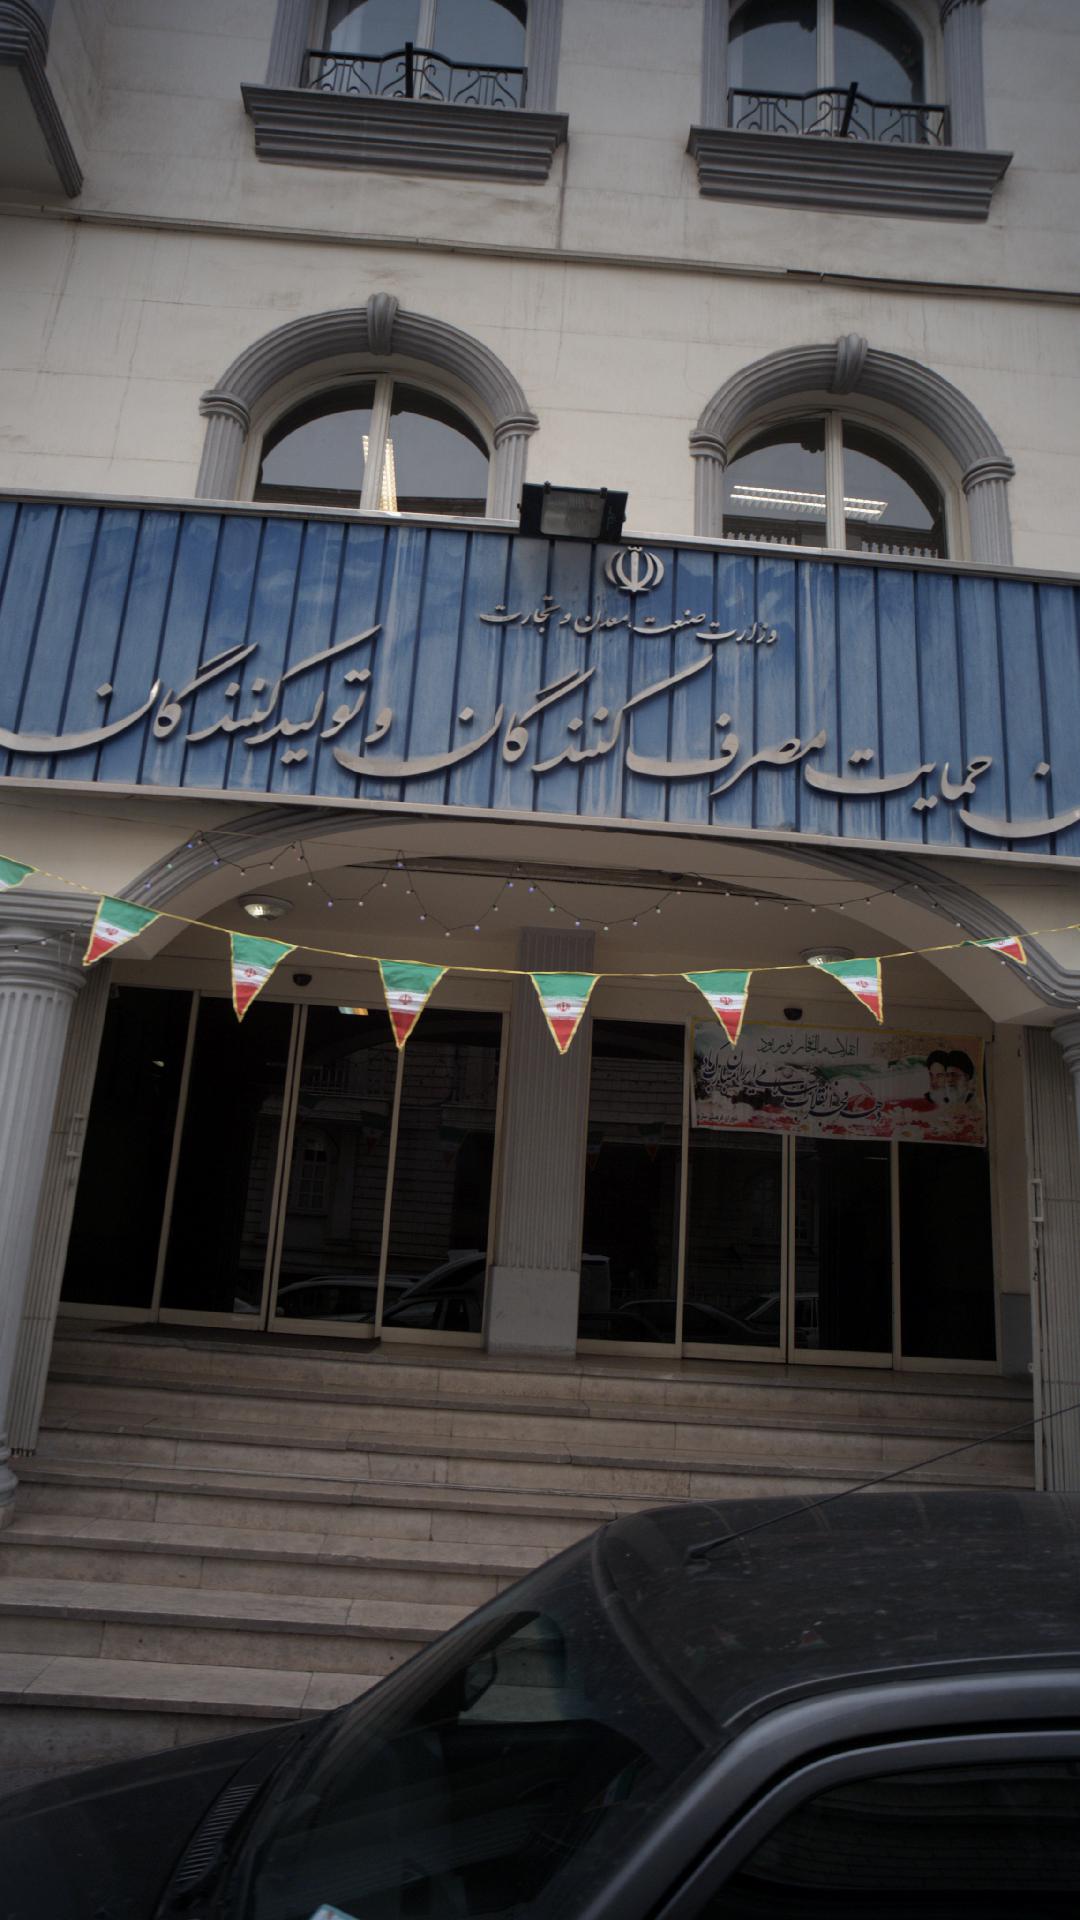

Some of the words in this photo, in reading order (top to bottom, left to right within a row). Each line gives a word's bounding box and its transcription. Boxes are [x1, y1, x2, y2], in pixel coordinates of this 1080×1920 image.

[479, 595, 560, 633] تجارت
[559, 609, 572, 625] و
[574, 610, 629, 634] معدن
[695, 621, 777, 645] وزارت
[246, 667, 372, 766] تولید
[364, 707, 393, 745] و
[804, 747, 993, 812] حمایت
